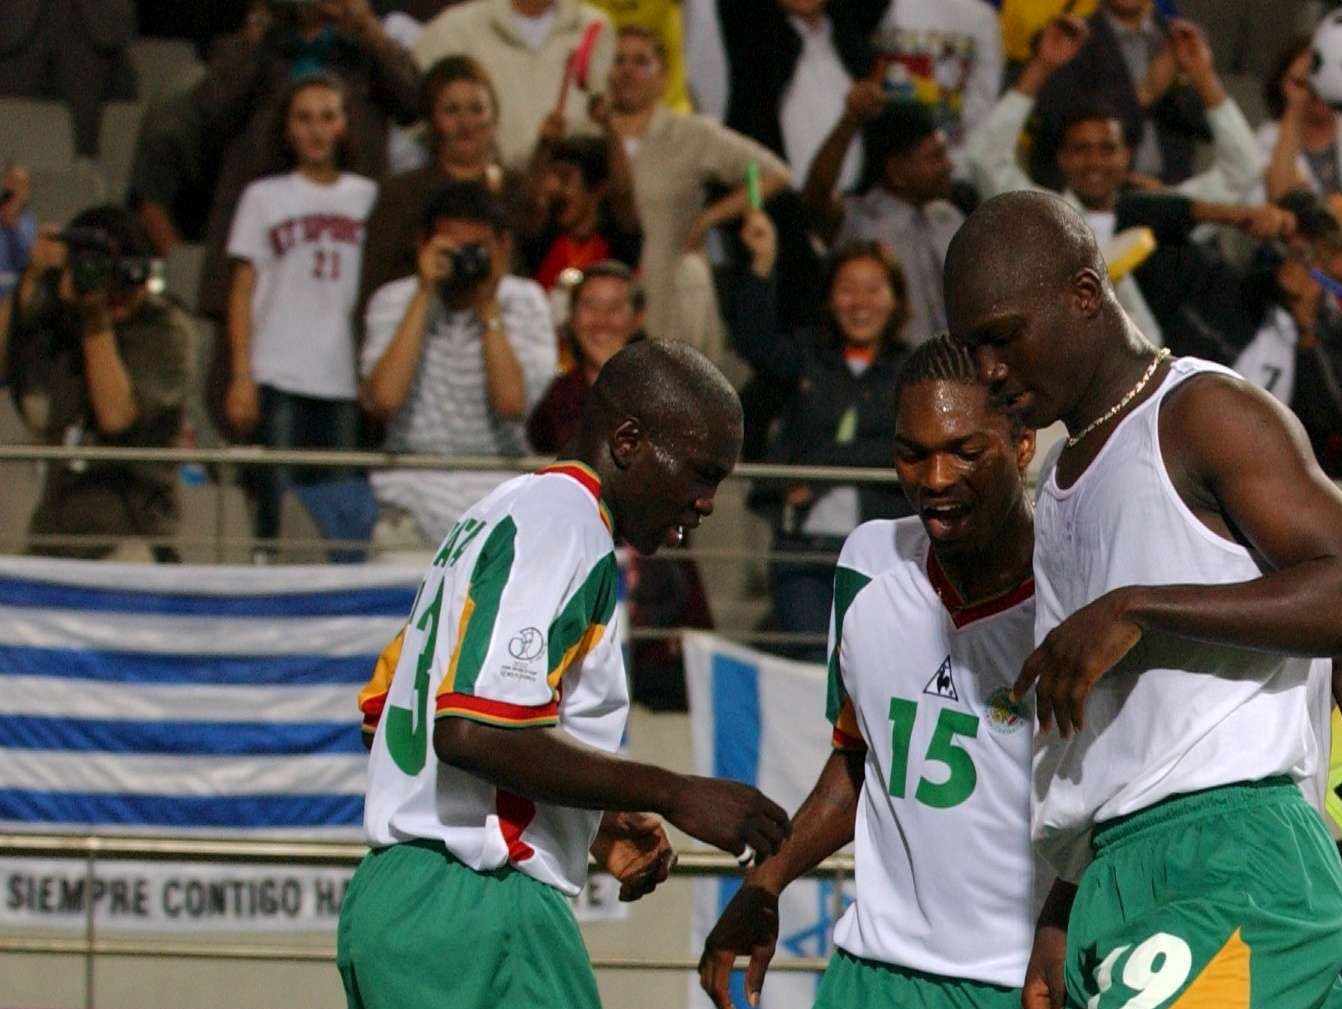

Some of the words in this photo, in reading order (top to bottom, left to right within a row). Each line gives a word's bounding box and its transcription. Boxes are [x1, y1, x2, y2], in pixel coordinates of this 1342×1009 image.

[386, 575, 444, 777] 3
[888, 697, 979, 808] 15
[7, 873, 150, 916] SIEMPRE
[162, 879, 301, 918] CONTIGO
